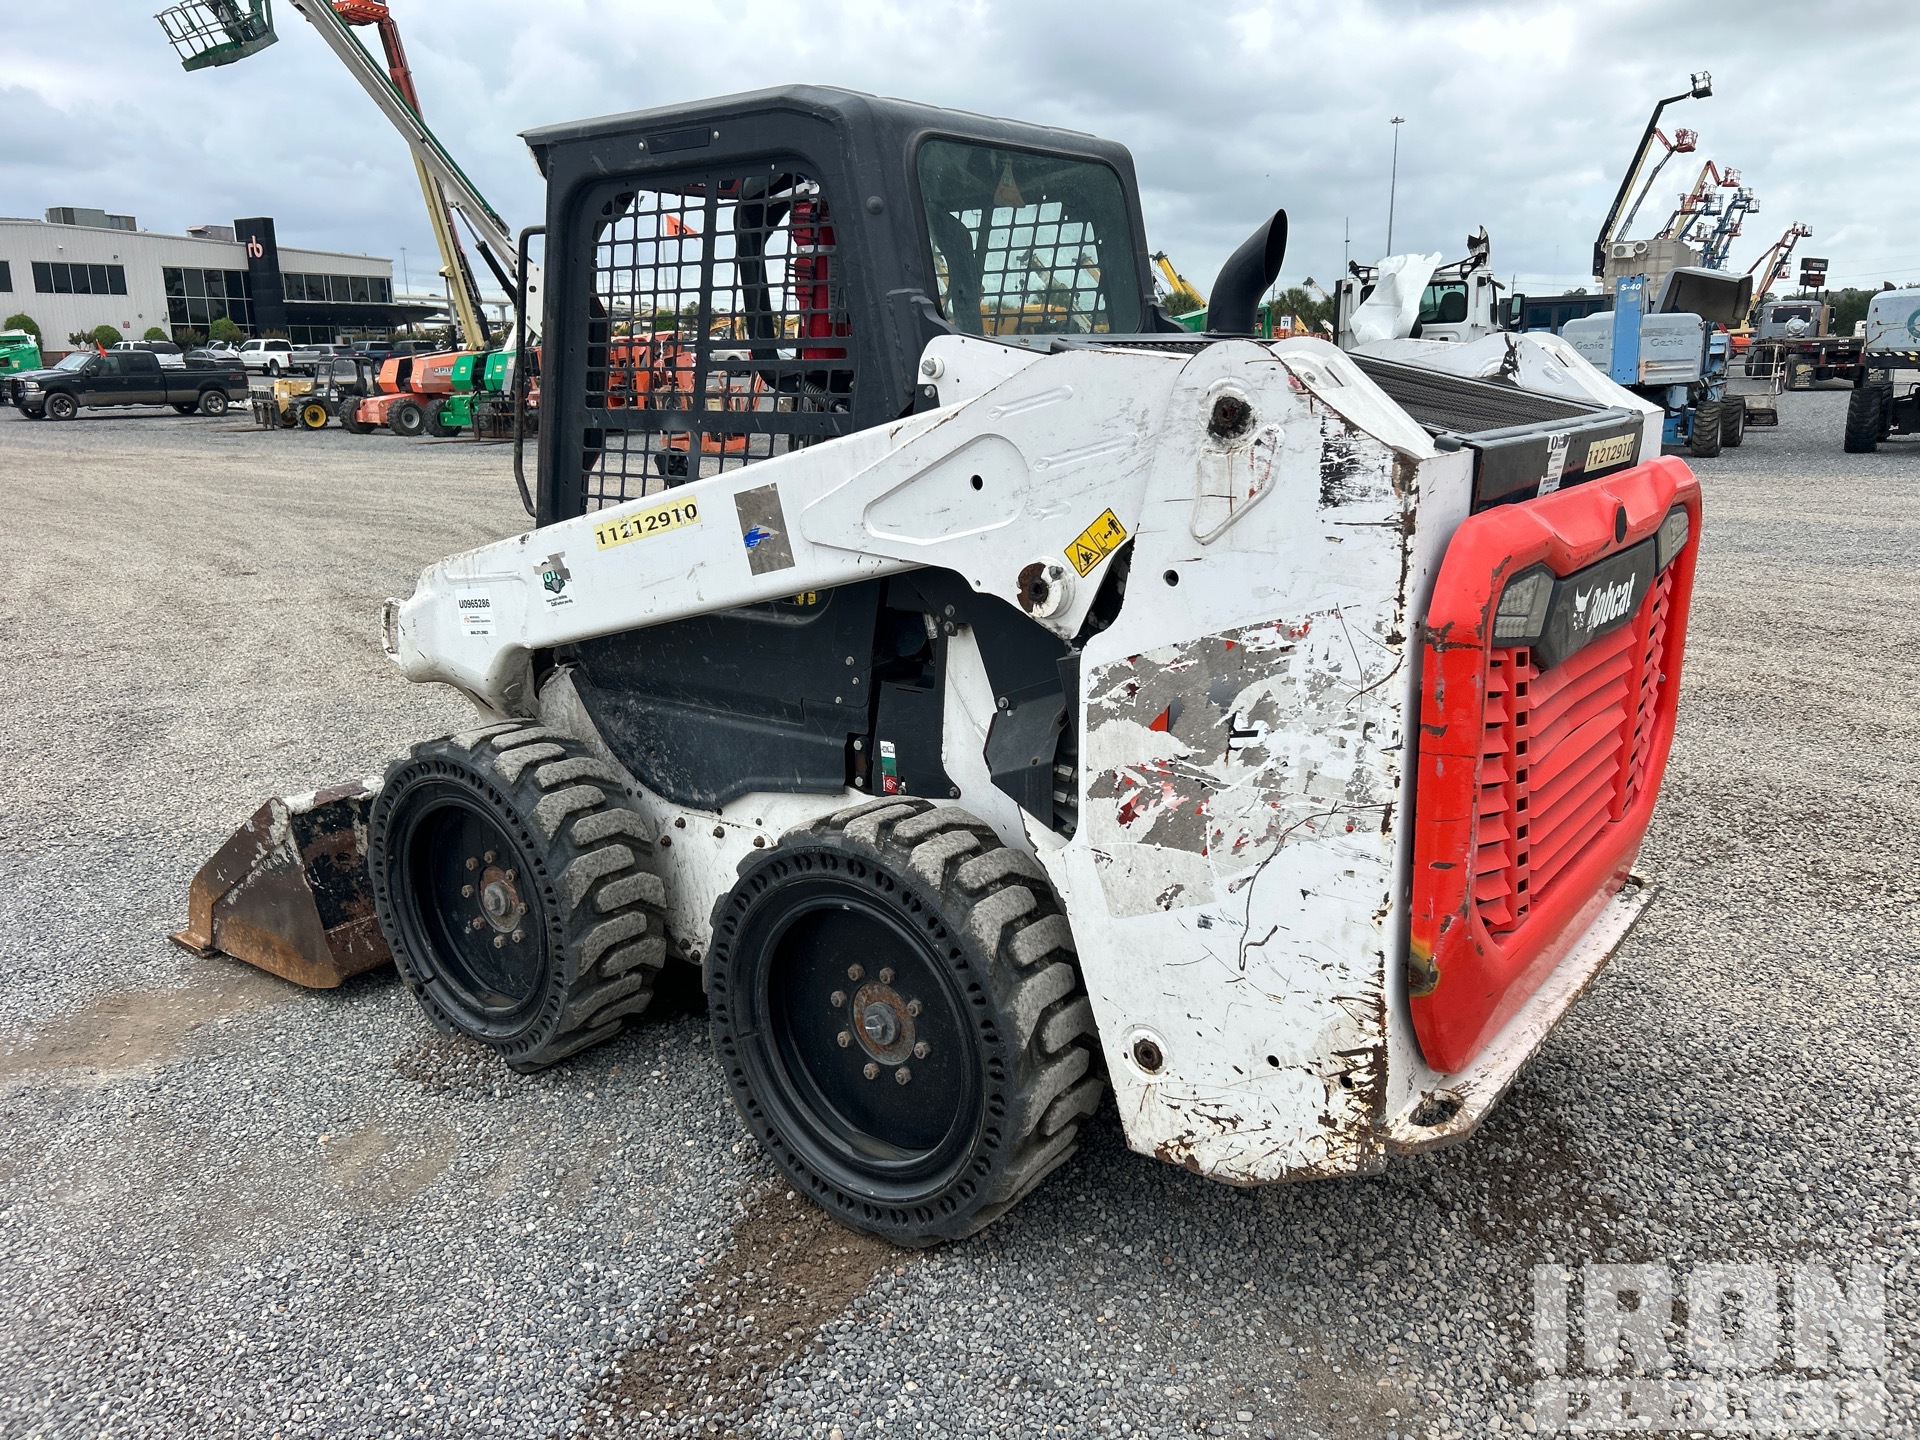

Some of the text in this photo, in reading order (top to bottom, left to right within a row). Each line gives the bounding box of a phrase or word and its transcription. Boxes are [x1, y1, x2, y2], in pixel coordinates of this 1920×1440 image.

[247, 235, 263, 258] rb
[1620, 282, 1642, 292] S-40
[1650, 337, 1684, 347] Genie
[596, 503, 698, 545] 11212910
[458, 598, 491, 609] U0965286
[1586, 572, 1636, 633] Bobcat
